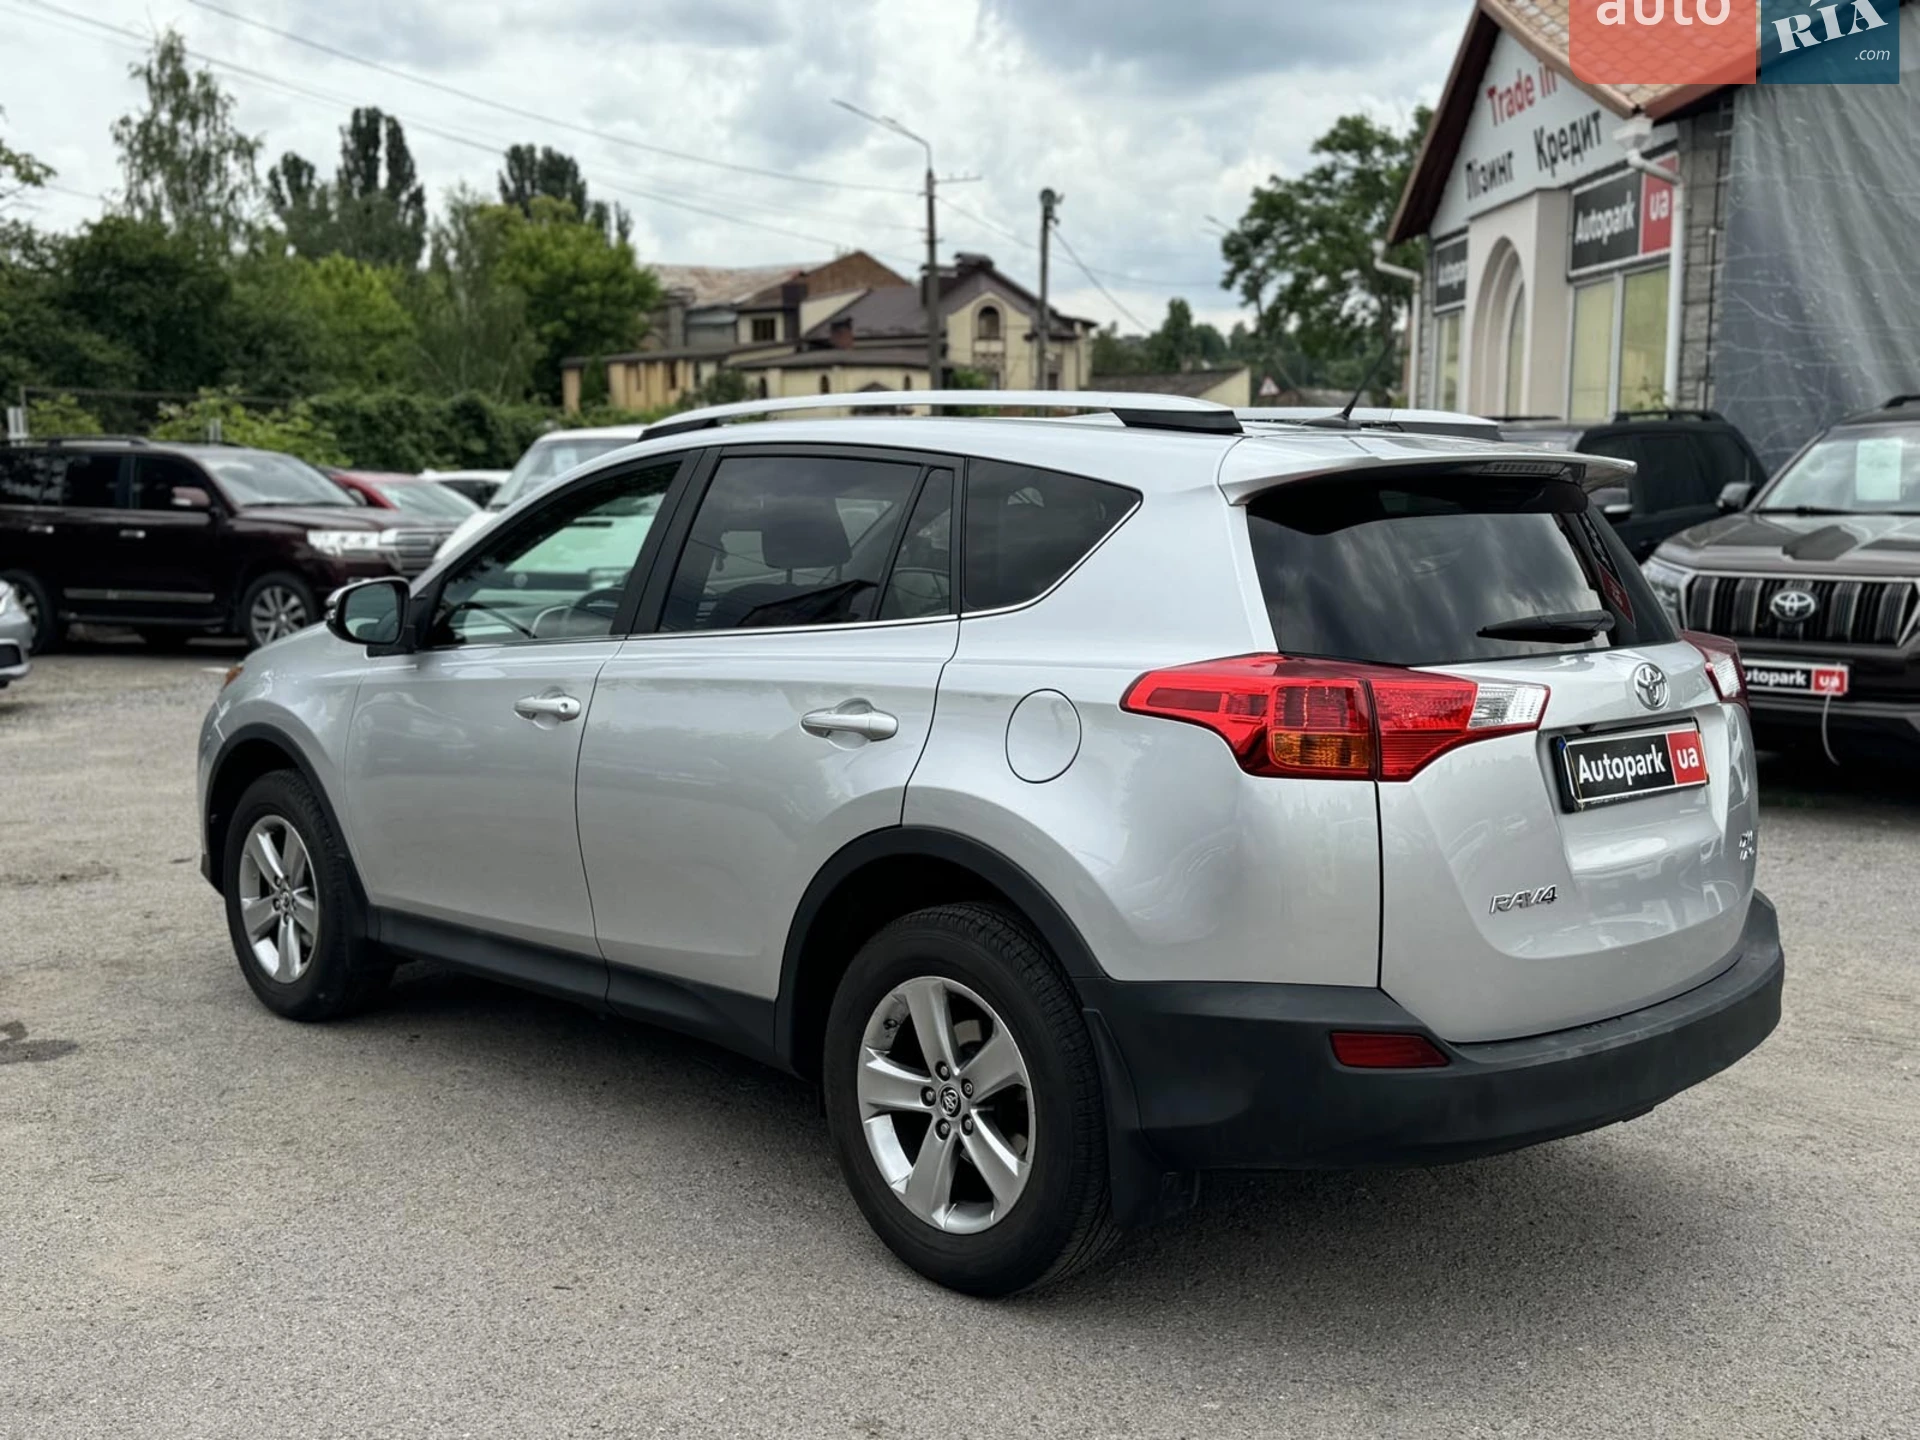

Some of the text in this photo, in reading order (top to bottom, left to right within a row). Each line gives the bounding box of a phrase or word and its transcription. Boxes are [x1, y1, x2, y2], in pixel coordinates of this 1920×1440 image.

[1486, 68, 1536, 127] Trade
[1466, 109, 1601, 200] Лізинг Кредит
[1574, 189, 1669, 246] Autopark ua
[1745, 669, 1840, 688] utopark ua
[1578, 744, 1699, 786] Autopark ua
[1489, 884, 1558, 914] RAV4
